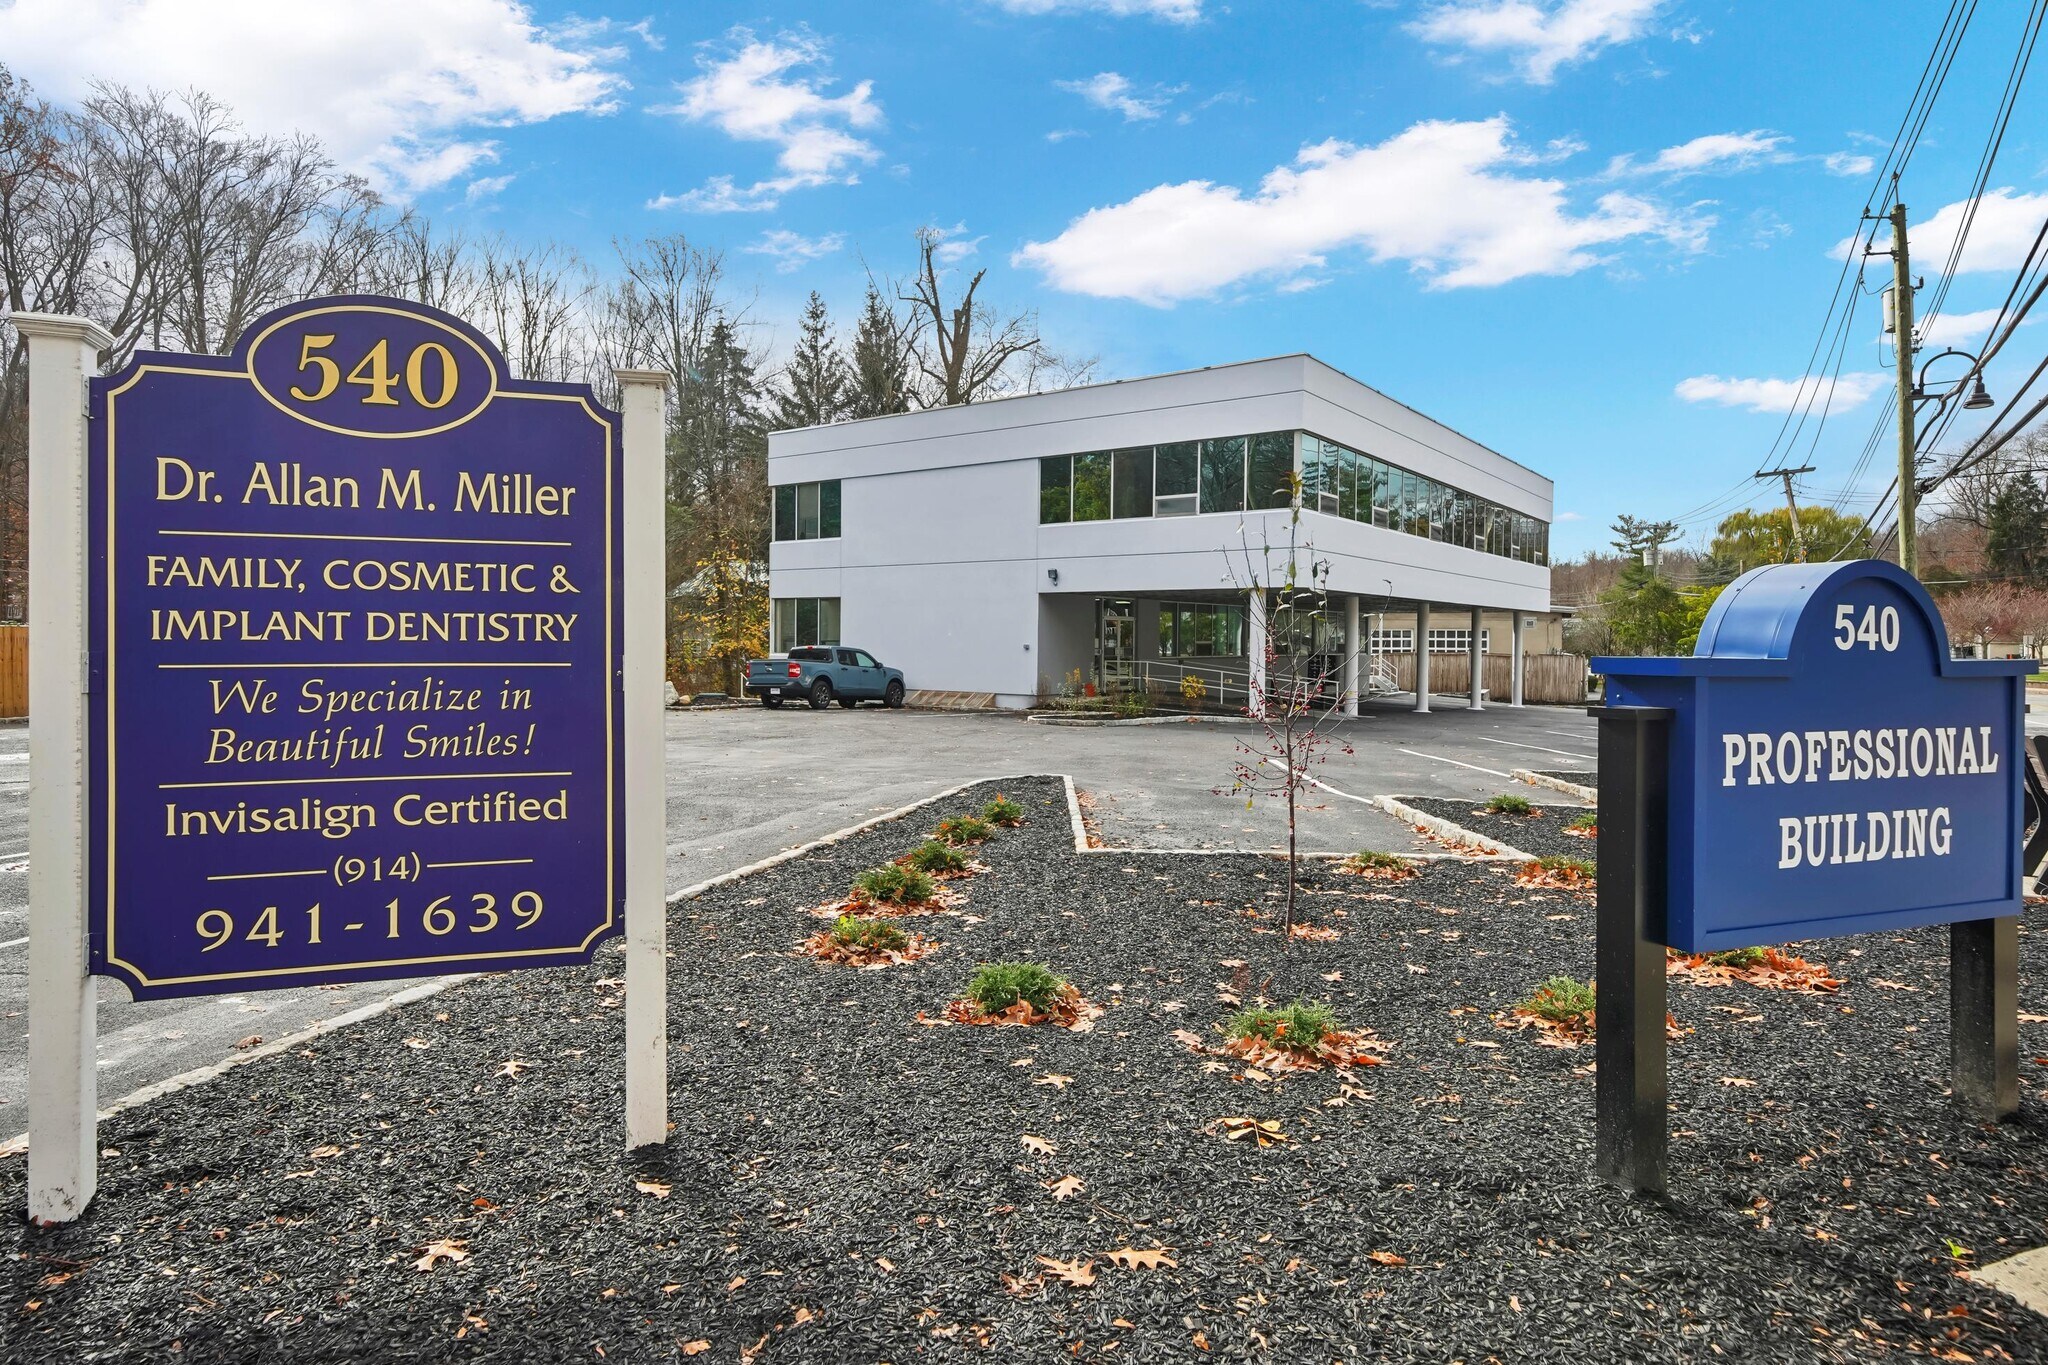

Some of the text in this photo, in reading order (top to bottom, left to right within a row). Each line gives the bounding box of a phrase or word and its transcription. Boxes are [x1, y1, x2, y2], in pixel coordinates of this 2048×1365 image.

[290, 333, 459, 409] 540
[156, 456, 576, 516] Dr. Allan M. Miller
[147, 555, 581, 594] FAMILY, COSMETIC &
[151, 609, 578, 642] IMPLANT DENTISTRY
[1834, 604, 1900, 652] 540
[208, 676, 532, 722] We Specialize in
[203, 722, 536, 769] Beautiful Smiles!
[1722, 726, 1999, 787] PROFESSIONAL
[165, 789, 568, 839] Invisalign Certified
[1778, 806, 1953, 870] BUILDING
[334, 851, 421, 887] (914)
[195, 890, 544, 953] 941-1639
